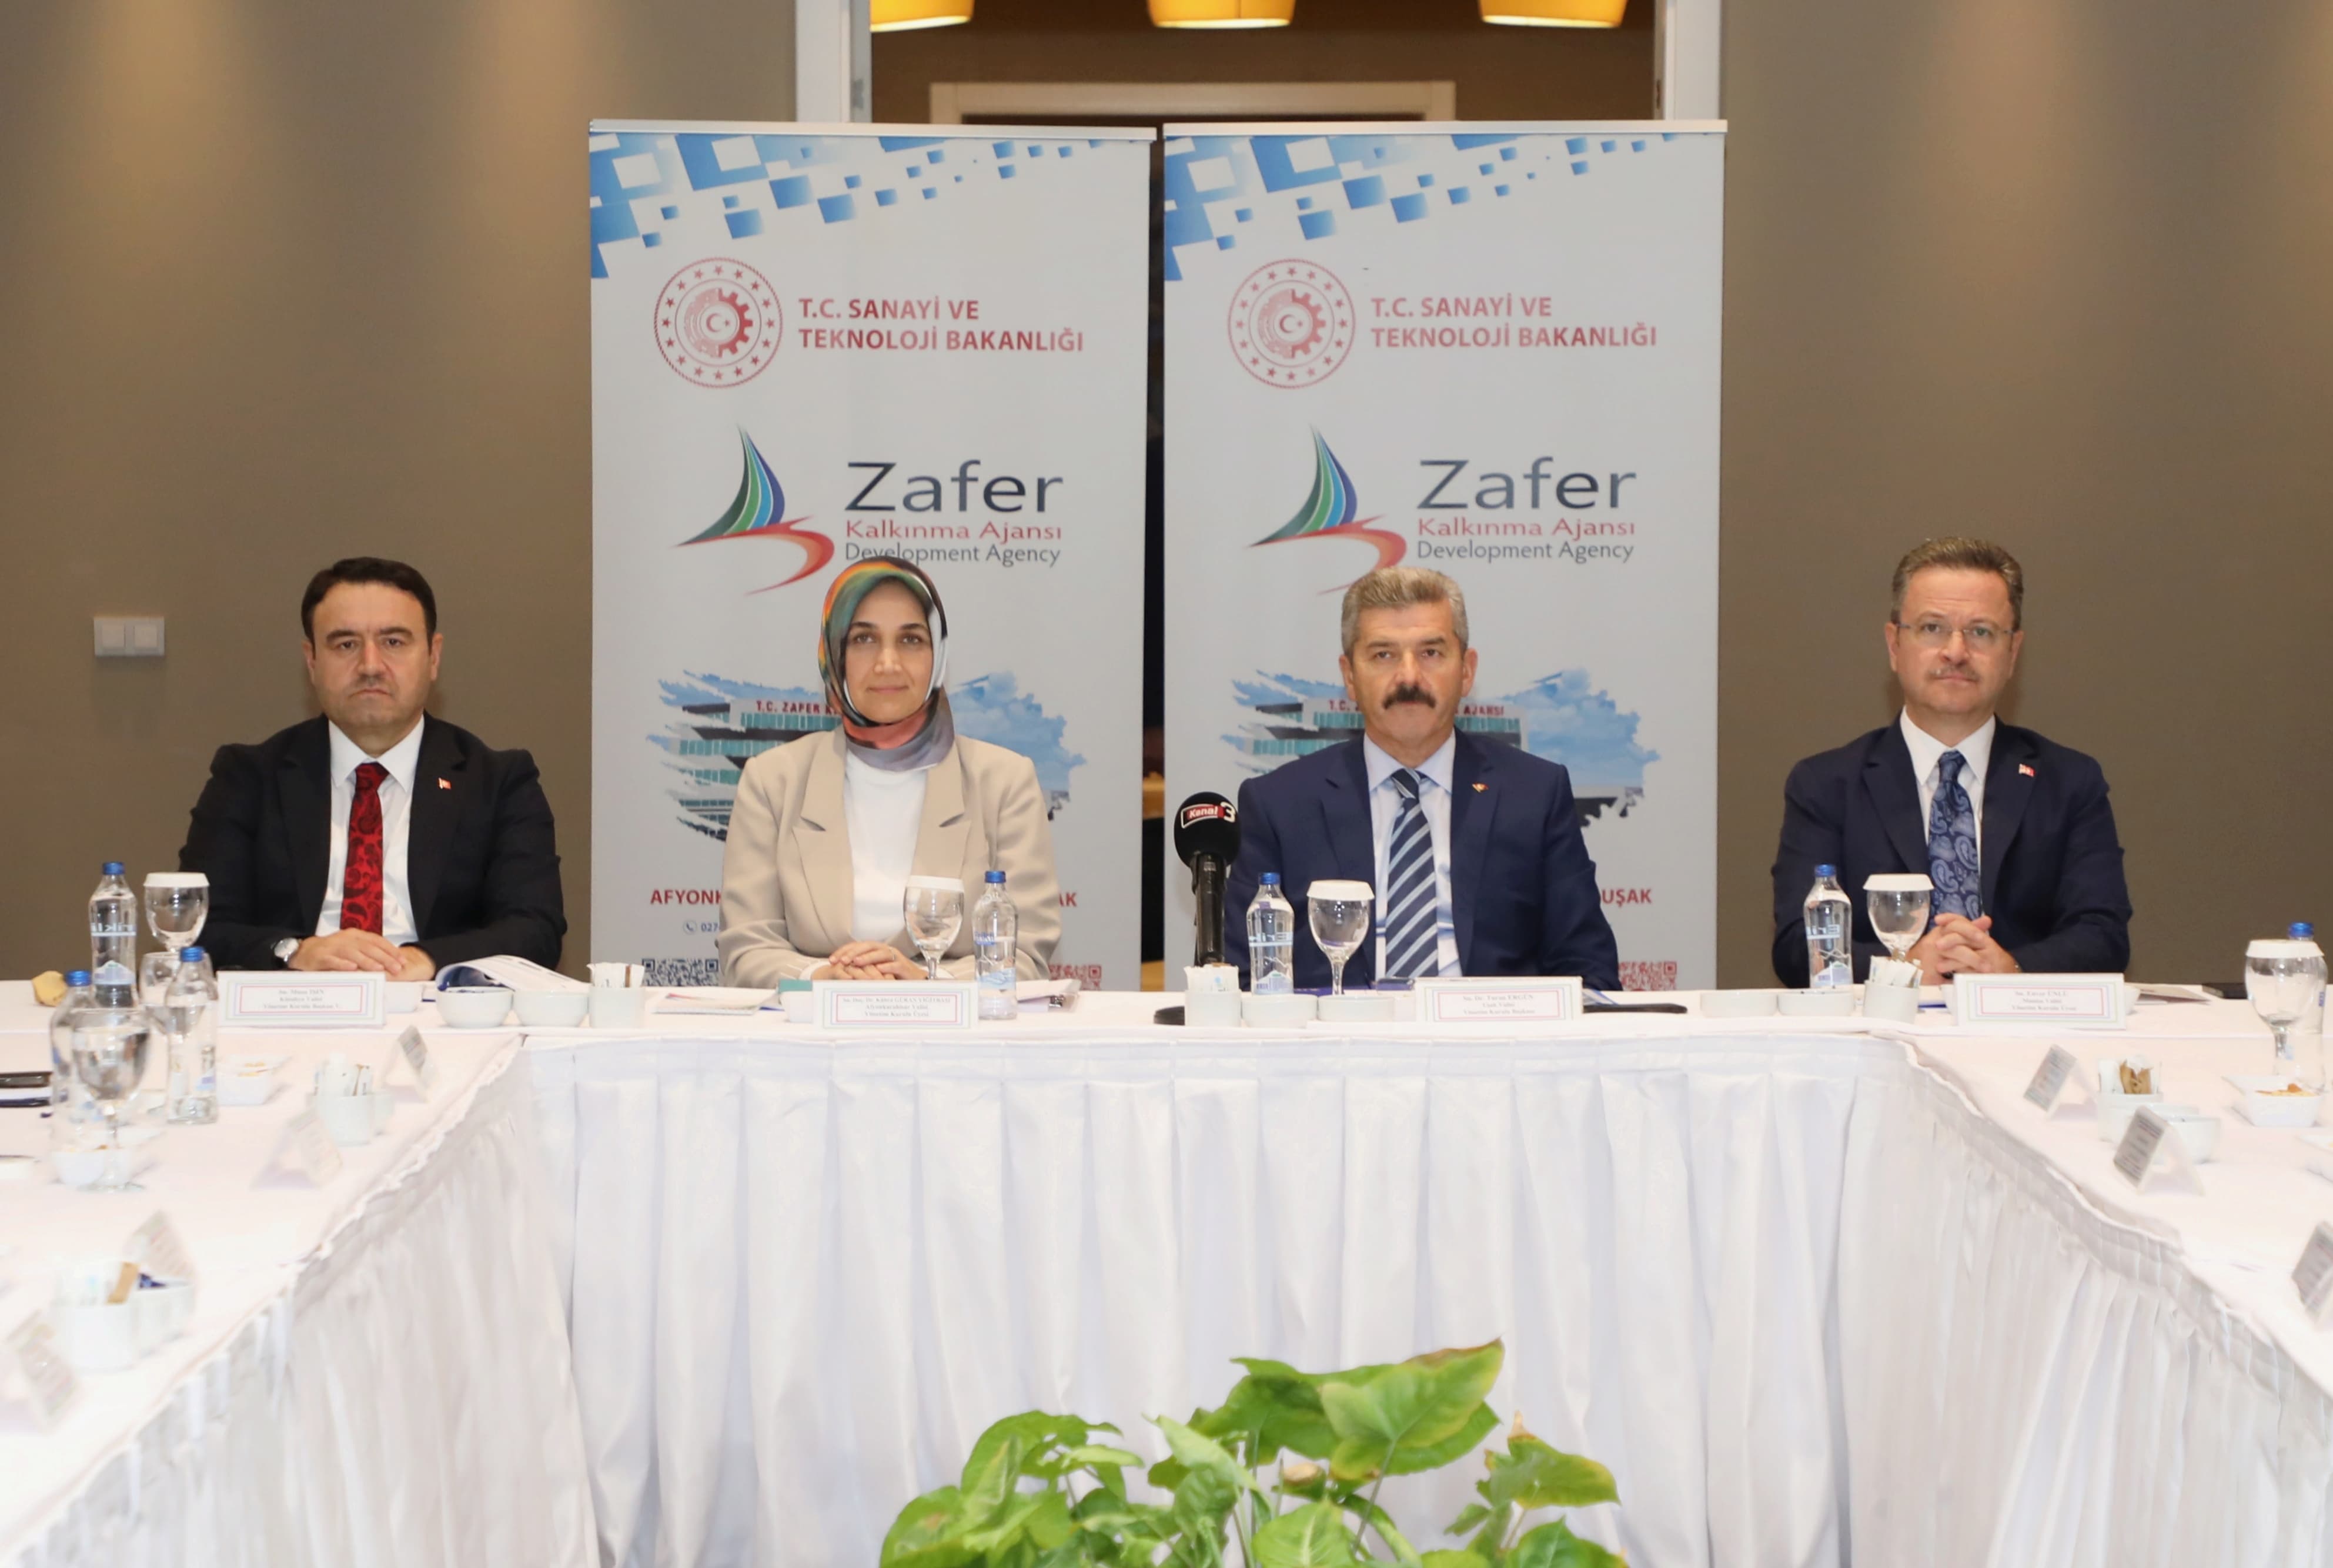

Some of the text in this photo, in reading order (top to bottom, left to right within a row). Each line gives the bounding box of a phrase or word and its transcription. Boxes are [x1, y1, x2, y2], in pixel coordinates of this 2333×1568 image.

[799, 296, 979, 320] T.C. SANAYİ VE
[1371, 293, 1552, 317] T.C. SANAYİ VE
[799, 326, 1084, 352] TEKNOLOJİ BAKANLIĞI
[1372, 322, 1657, 347] TEKNOLOJİ BAKANLIĞI
[845, 460, 1064, 512] Zafer
[1417, 457, 1636, 509] Zafer
[846, 519, 1062, 544] Kalkınma Ajansı
[1418, 517, 1635, 541] Kalkınma Ajansı
[845, 542, 1061, 568] Development Agency
[1418, 541, 1635, 564] Development Agency
[756, 700, 777, 712] T.C.
[1189, 801, 1236, 823] Kanal 3
[1602, 888, 1652, 908] UŞAK
